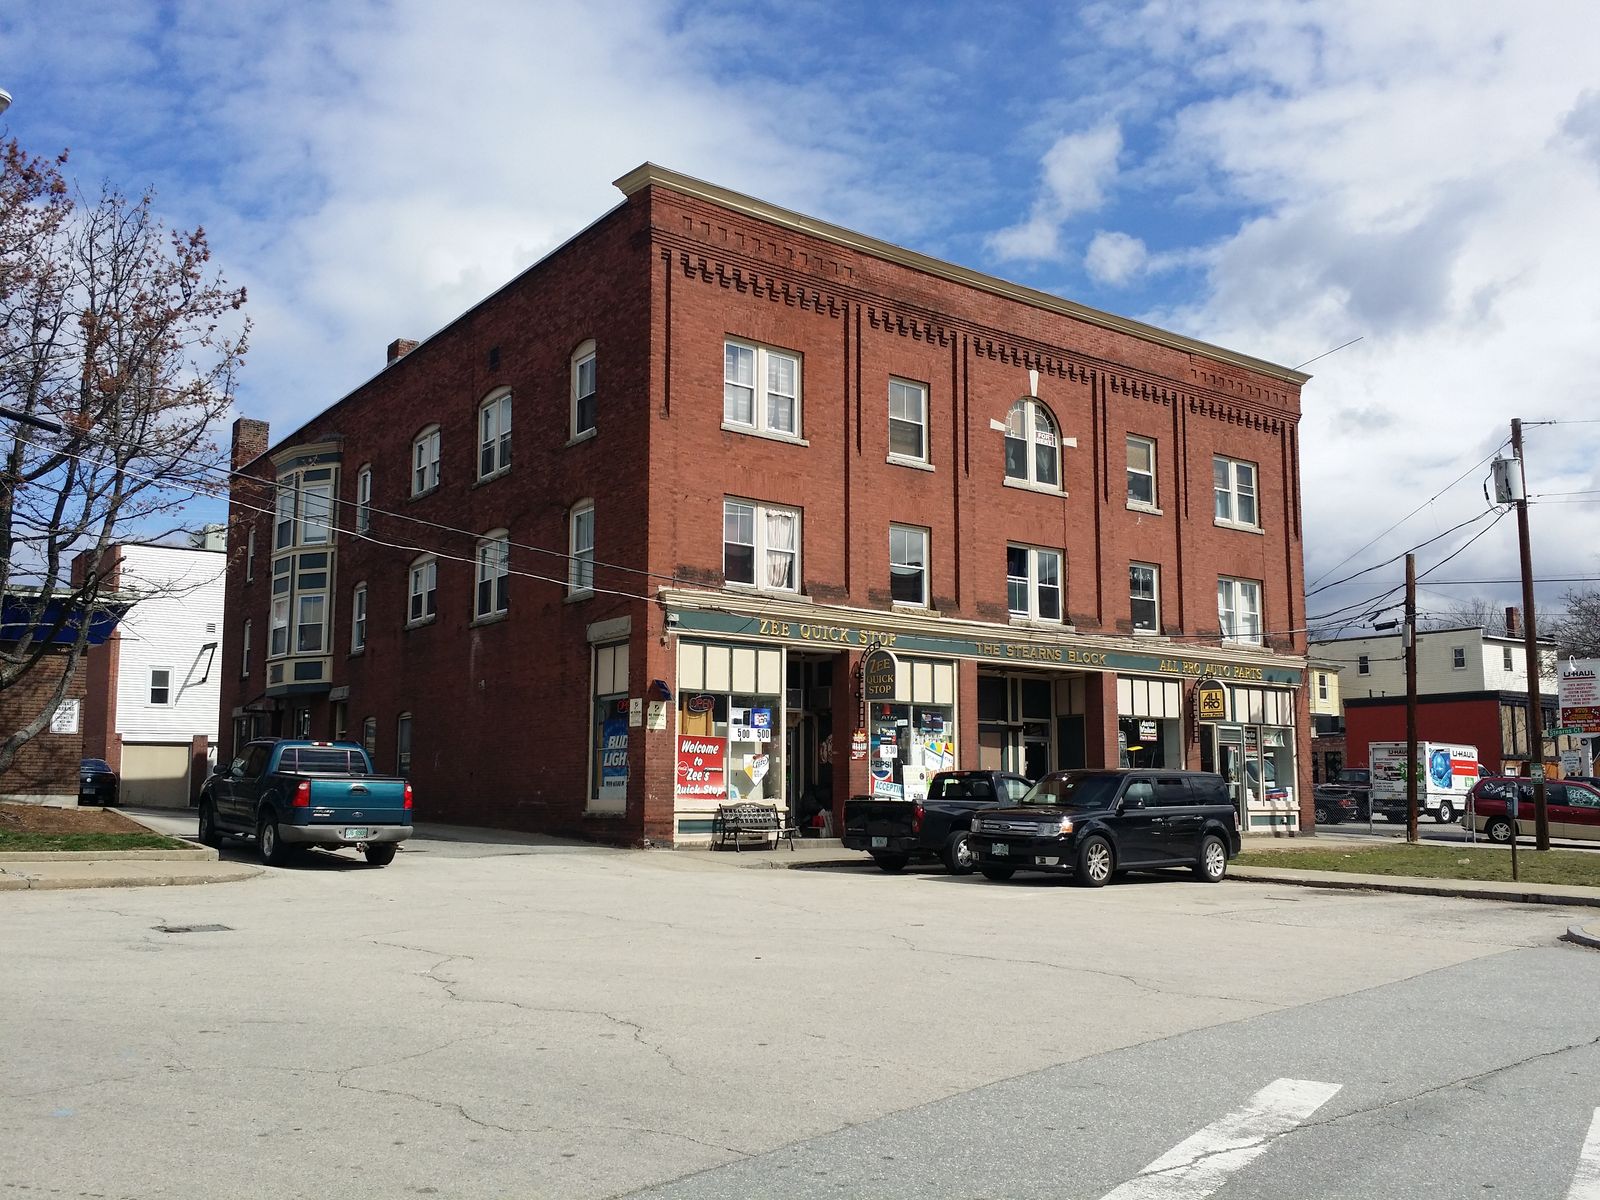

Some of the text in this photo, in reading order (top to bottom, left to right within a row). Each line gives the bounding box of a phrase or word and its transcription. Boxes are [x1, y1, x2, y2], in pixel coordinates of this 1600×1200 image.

[1037, 432, 1049, 440] FOR
[760, 619, 897, 646] ZEE QUICK STOP
[976, 642, 1107, 665] THE STEARNS BLOCK
[869, 658, 890, 673] ZEE
[1160, 660, 1263, 679] ALL PRO AUTO PARTS
[866, 674, 894, 684] QUICK
[868, 685, 892, 694] STOP
[1204, 692, 1220, 701] ALL
[1203, 701, 1220, 709] PRO
[608, 734, 628, 749] BUD
[681, 740, 720, 755] Welcome
[603, 752, 627, 766] LIGH
[1452, 750, 1475, 759] U-HAUL
[693, 757, 703, 766] to
[871, 760, 892, 768] PEPSI
[686, 768, 710, 781] Zee's
[676, 784, 723, 797] Quick Stop
